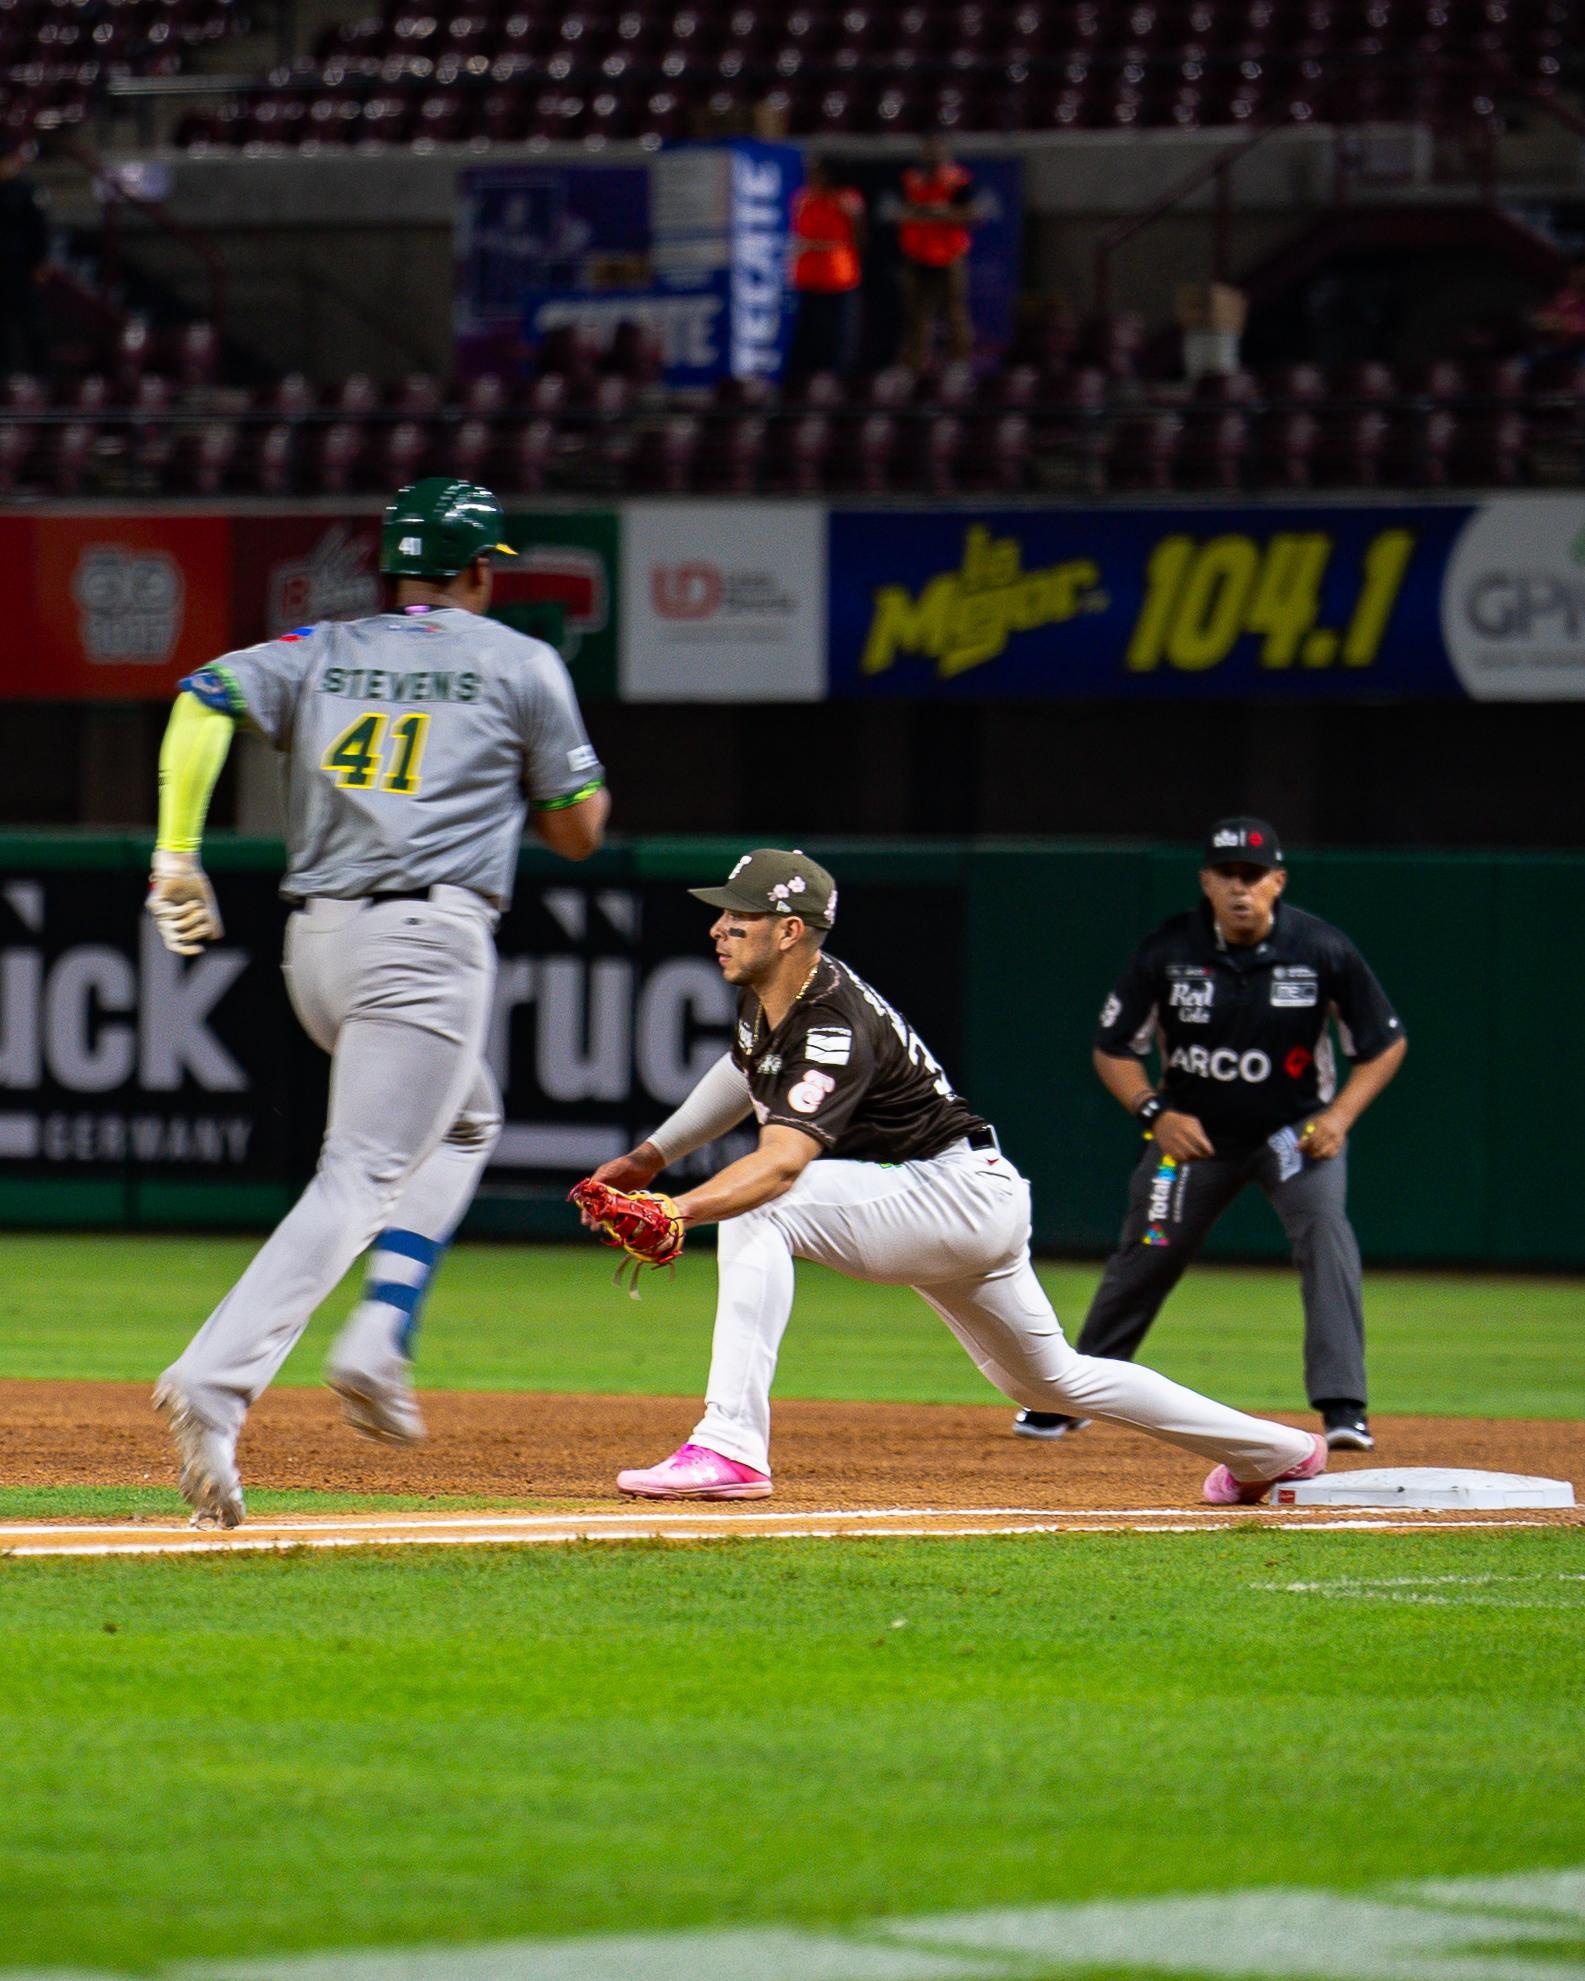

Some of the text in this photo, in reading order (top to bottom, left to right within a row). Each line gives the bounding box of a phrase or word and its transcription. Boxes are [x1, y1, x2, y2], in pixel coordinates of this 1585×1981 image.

[1126, 530, 1413, 672] 104.1
[324, 667, 482, 701] STEVENS
[320, 712, 432, 795] 41
[1167, 1044, 1272, 1083] ARCO
[46, 1112, 253, 1163] GERMANY
